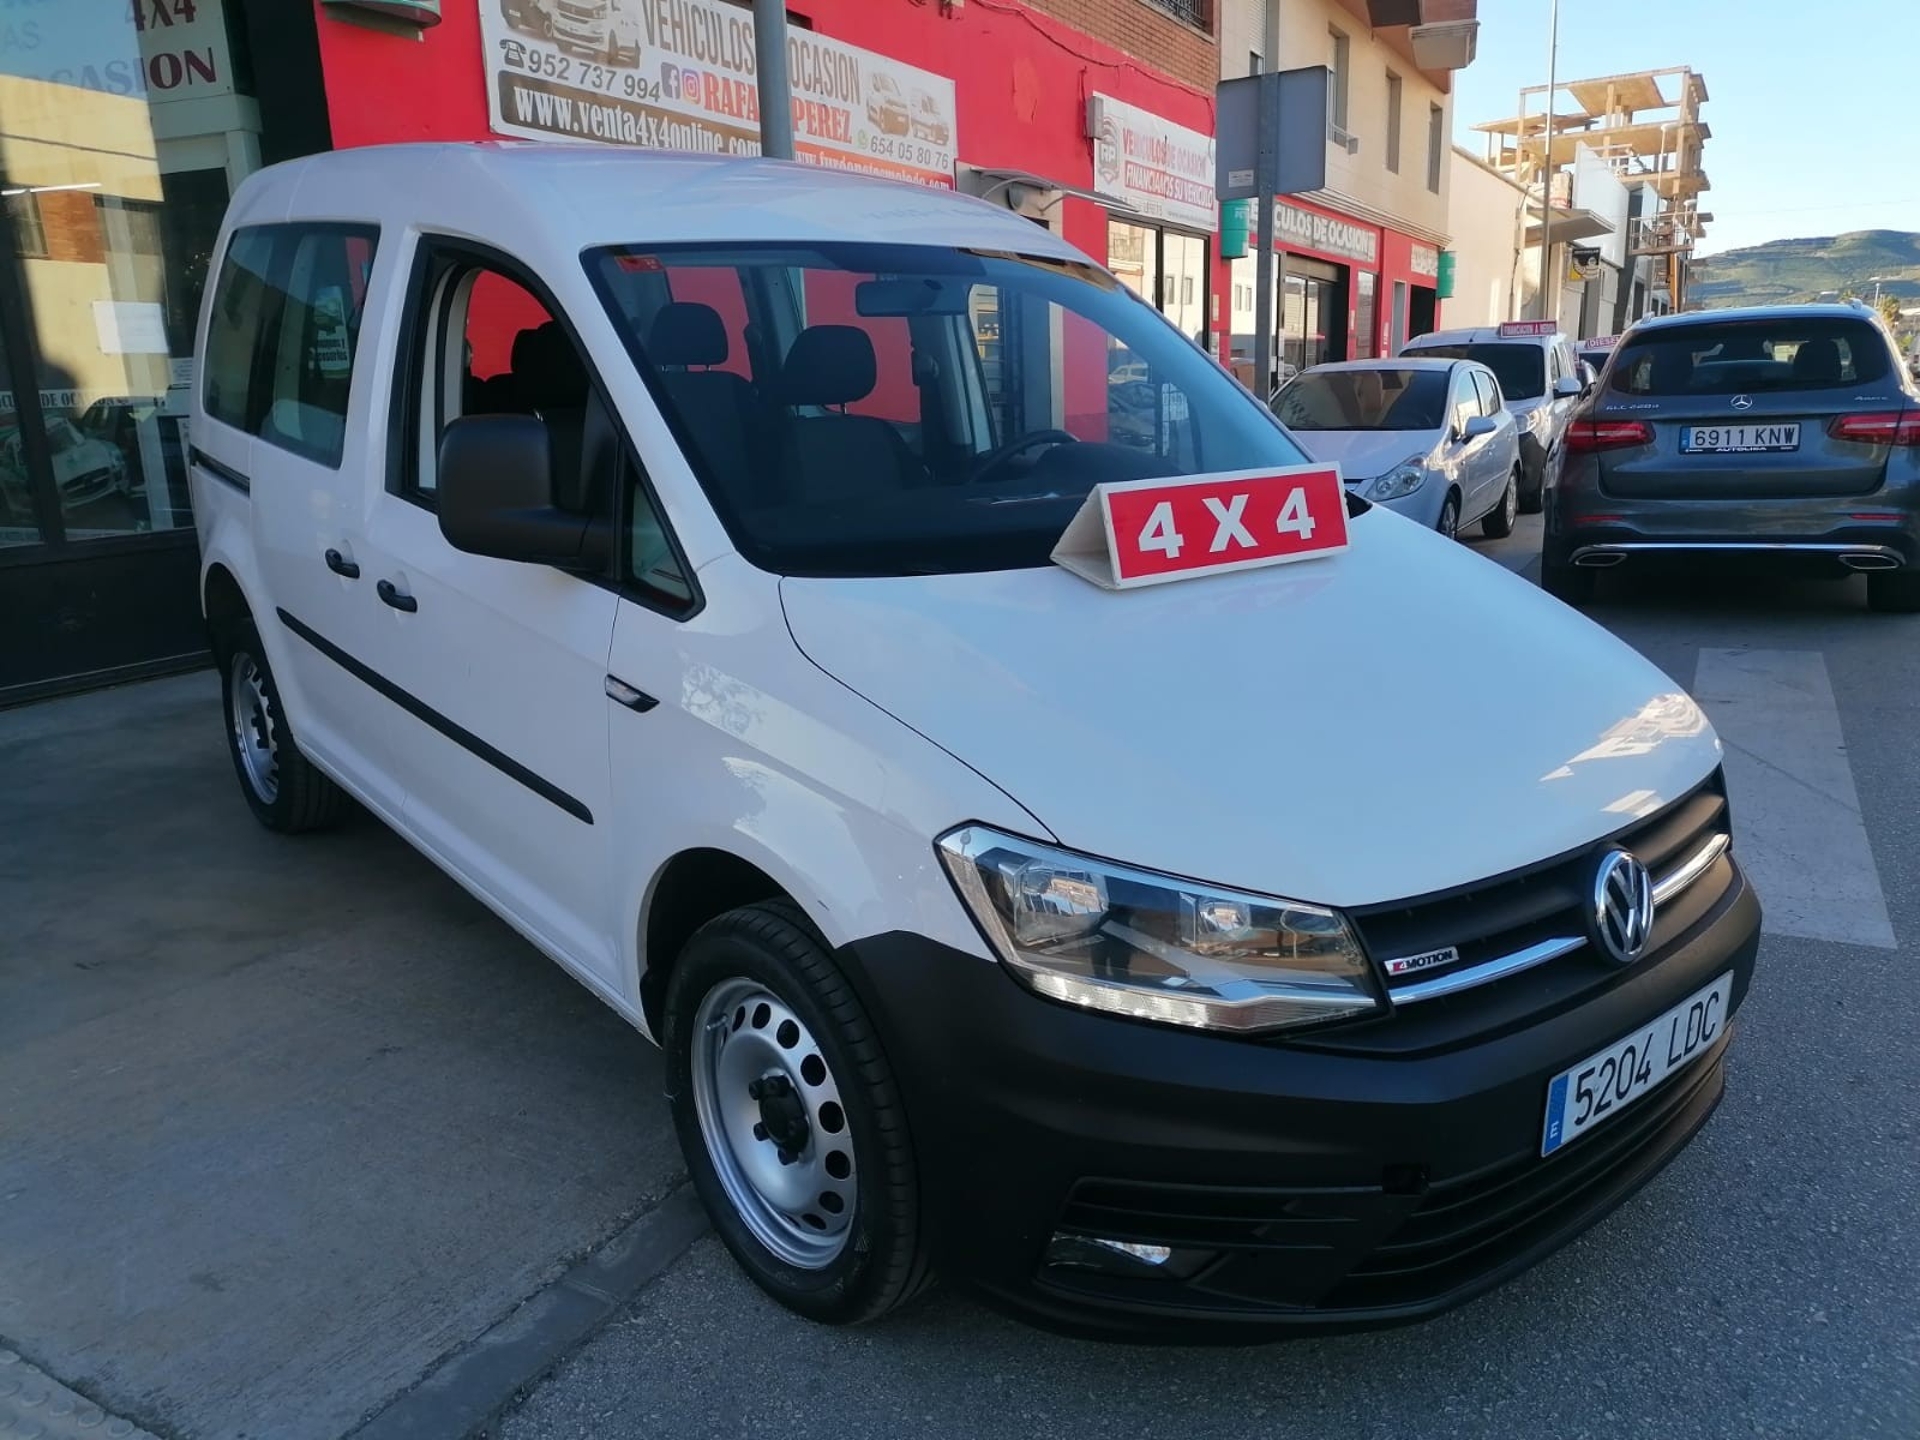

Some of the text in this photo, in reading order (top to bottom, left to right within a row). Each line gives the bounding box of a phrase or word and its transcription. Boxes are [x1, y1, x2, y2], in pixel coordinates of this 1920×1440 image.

[529, 50, 661, 102] 952 737 994
[641, 0, 861, 105] VEHICULOS OCASION
[513, 86, 762, 157] www.venta4x4onlinecom
[791, 95, 852, 143] PEREZ
[870, 135, 949, 169] 654 05 80 76
[1313, 216, 1327, 240] DE
[1328, 221, 1369, 252] OCASION
[1695, 427, 1796, 446] 6911 KNW
[1138, 487, 1316, 559] 4 X 4
[1574, 992, 1720, 1126] 5204 LDC
